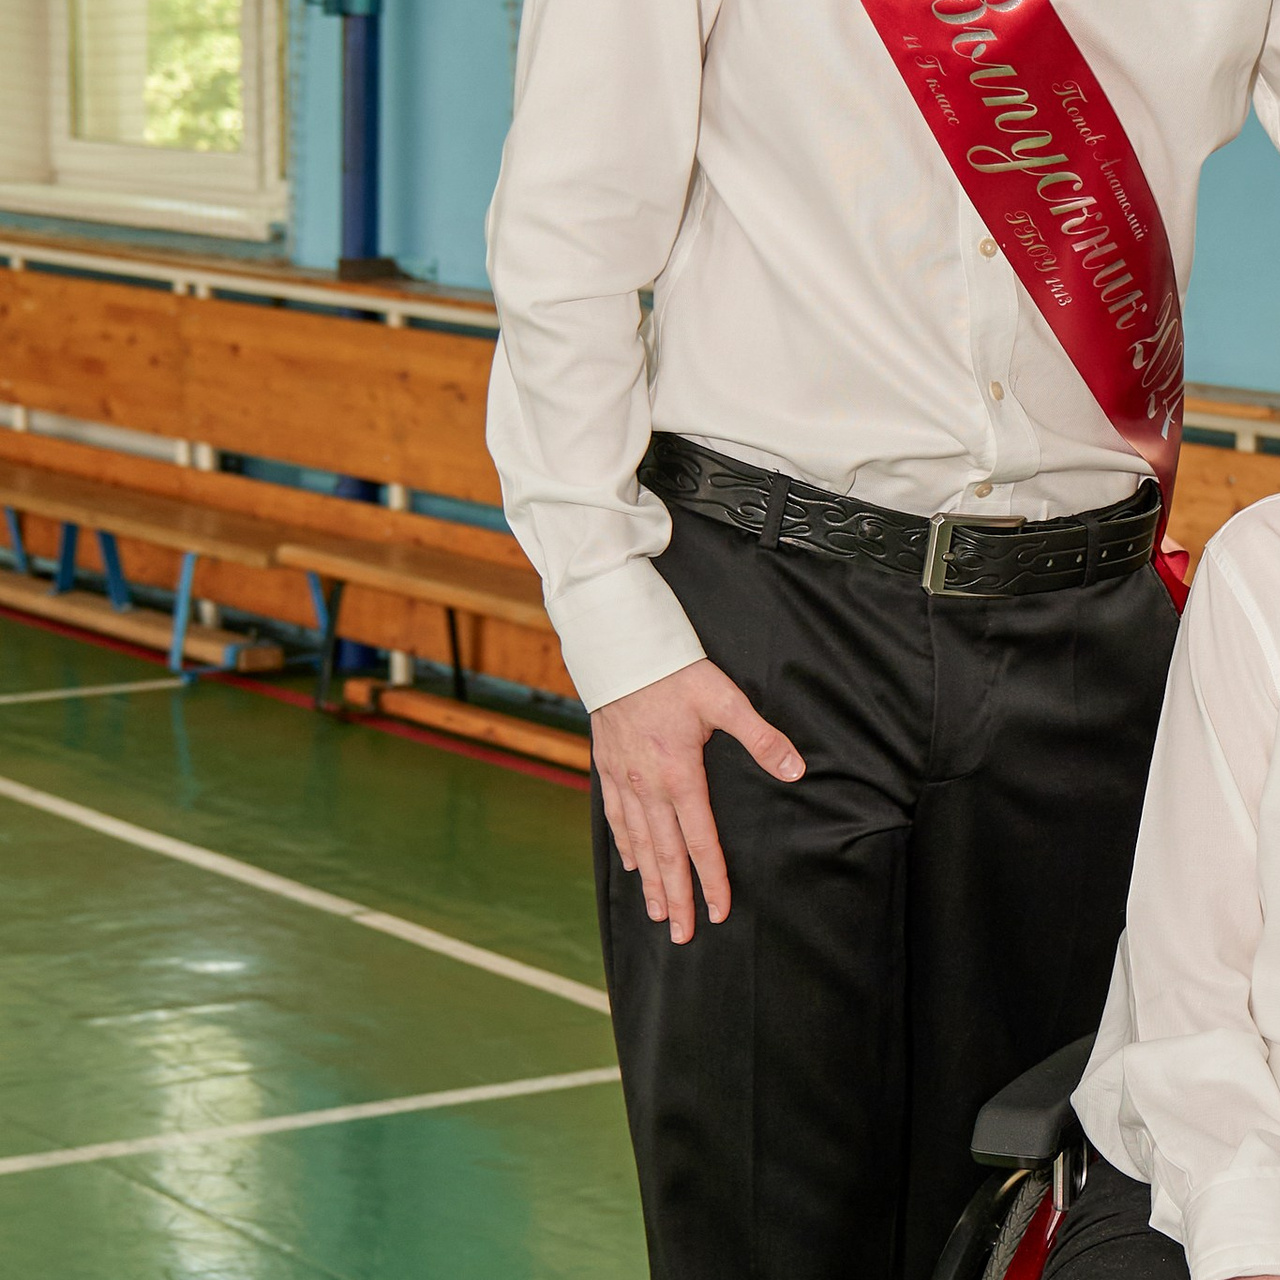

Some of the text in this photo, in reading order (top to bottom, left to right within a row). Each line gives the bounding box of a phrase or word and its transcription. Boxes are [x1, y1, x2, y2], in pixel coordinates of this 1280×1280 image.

[925, 79, 960, 126] класс
[1051, 80, 1148, 242] Попов Анатолий
[1004, 210, 1073, 307] ГБОУ 1413
